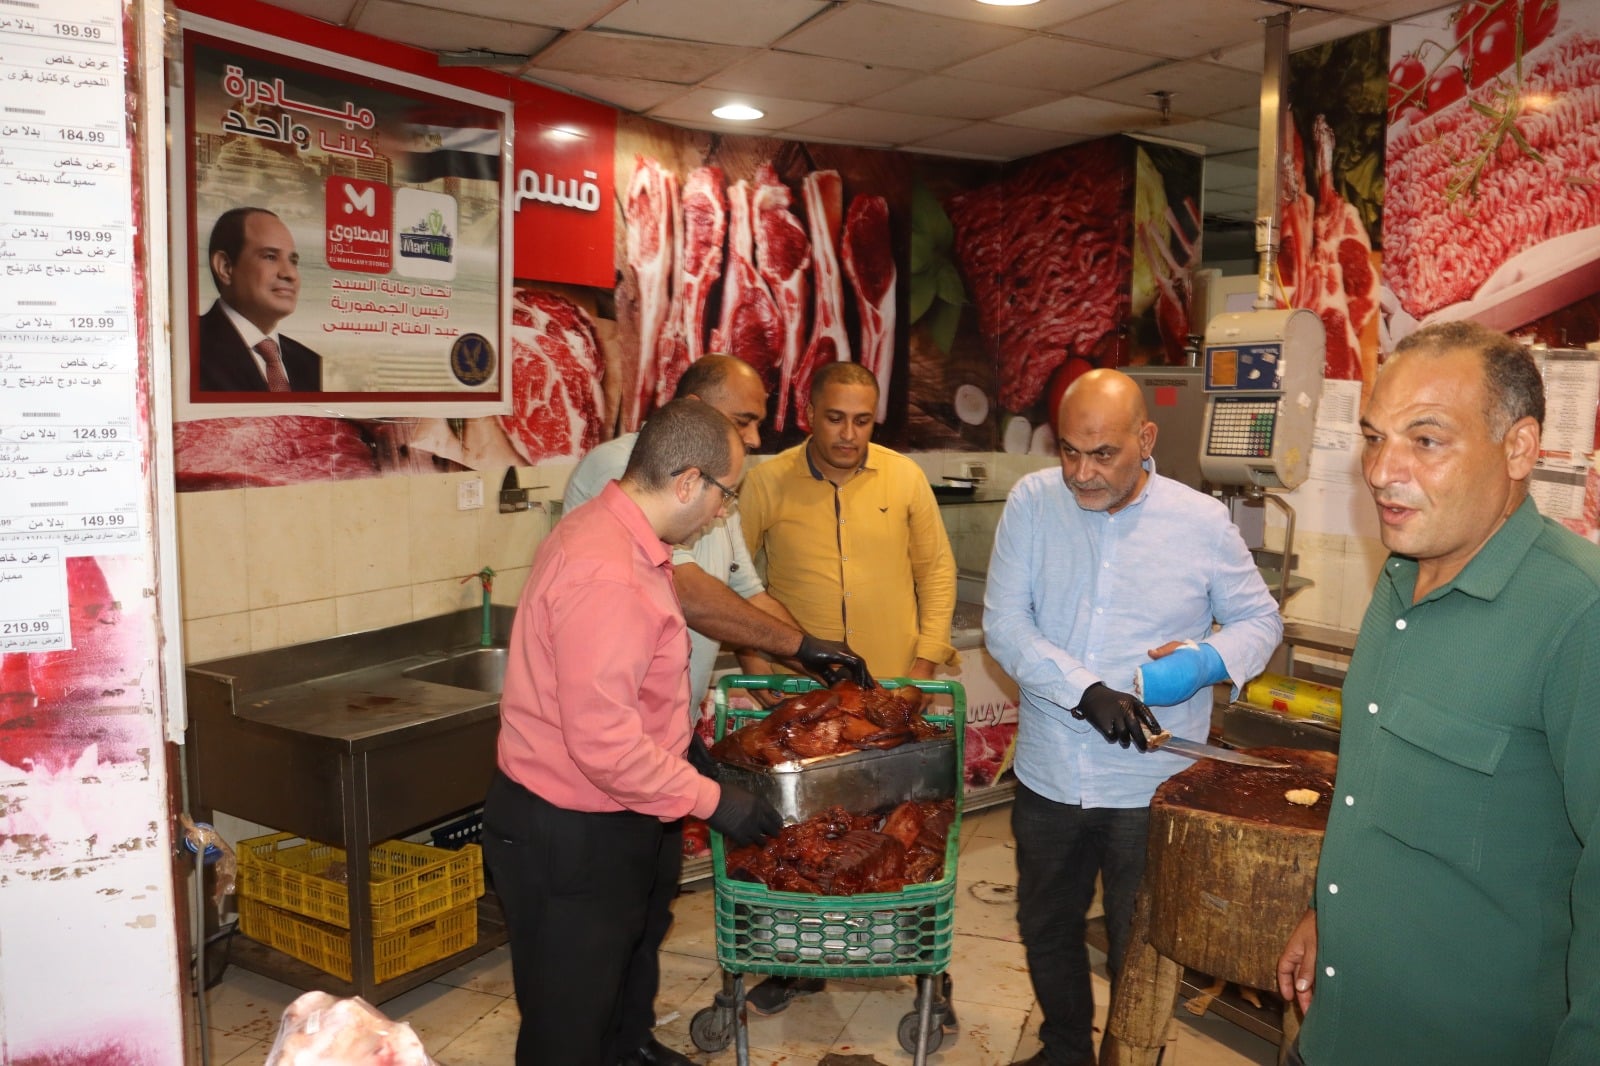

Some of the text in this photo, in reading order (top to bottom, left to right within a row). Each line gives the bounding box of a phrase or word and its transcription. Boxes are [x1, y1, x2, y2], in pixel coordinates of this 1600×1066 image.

[16, 19, 35, 31] بدلا
[53, 24, 101, 39] 199.99
[45, 55, 110, 70] عرض خاص
[224, 64, 375, 130] مبادرة
[2, 125, 105, 143] 184.99 بدلا من
[222, 109, 375, 160] كلنا واحد
[53, 157, 116, 171] عرض خاص
[514, 169, 600, 212] قسم
[11, 228, 112, 242] 199.99 بدلا من
[55, 245, 116, 258] عرض خاص
[46, 263, 70, 276] دجاج
[332, 278, 452, 298] تحت رعاية السيد
[331, 296, 448, 319] رئيس الجمهورية
[16, 317, 114, 329] 129.99 بدلا من
[323, 319, 459, 338] عبد الفتاح السيسى
[61, 358, 118, 369] رض خاص
[57, 377, 77, 388] دوج
[81, 376, 102, 387] هوت
[20, 428, 117, 440] 124.99 بدلا من
[28, 465, 48, 476] عنب
[53, 467, 75, 477] ورق
[78, 464, 107, 477] محشى
[28, 515, 124, 530] 149.99 بدلا من
[22, 551, 51, 563] عرض
[4, 622, 49, 634] 219.99
